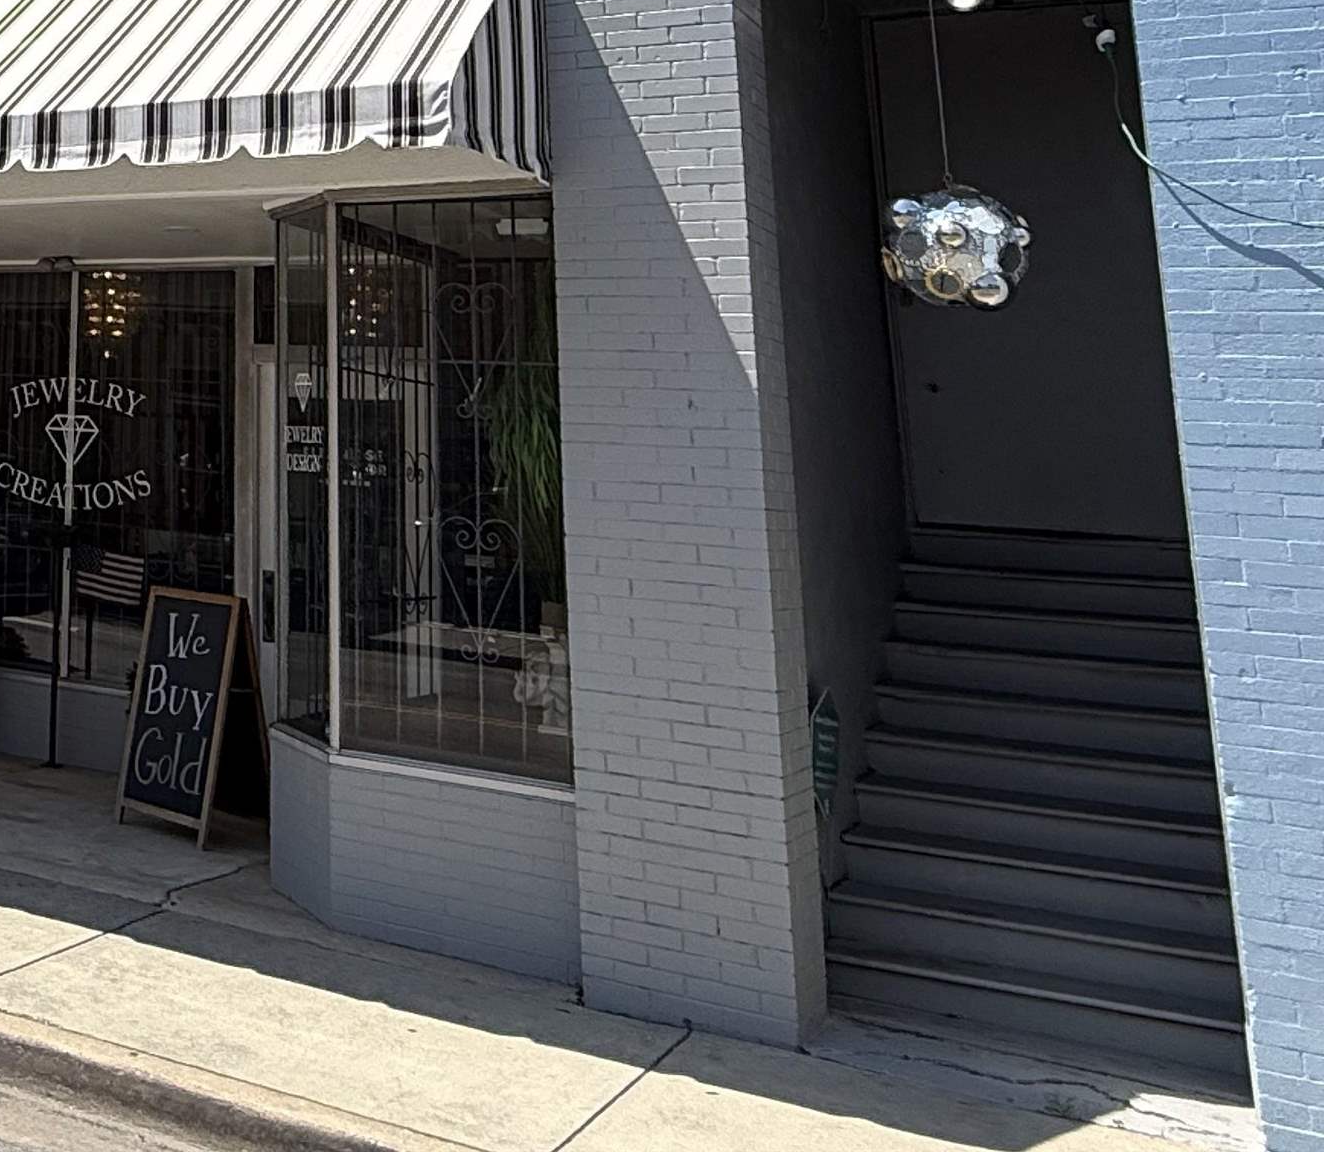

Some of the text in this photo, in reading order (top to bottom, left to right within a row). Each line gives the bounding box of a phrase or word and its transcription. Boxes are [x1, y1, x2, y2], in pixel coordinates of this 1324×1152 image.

[10, 377, 147, 418] JEWELRY
[284, 425, 324, 444] EWELRY
[167, 612, 211, 660] We
[134, 727, 207, 795] Gold
